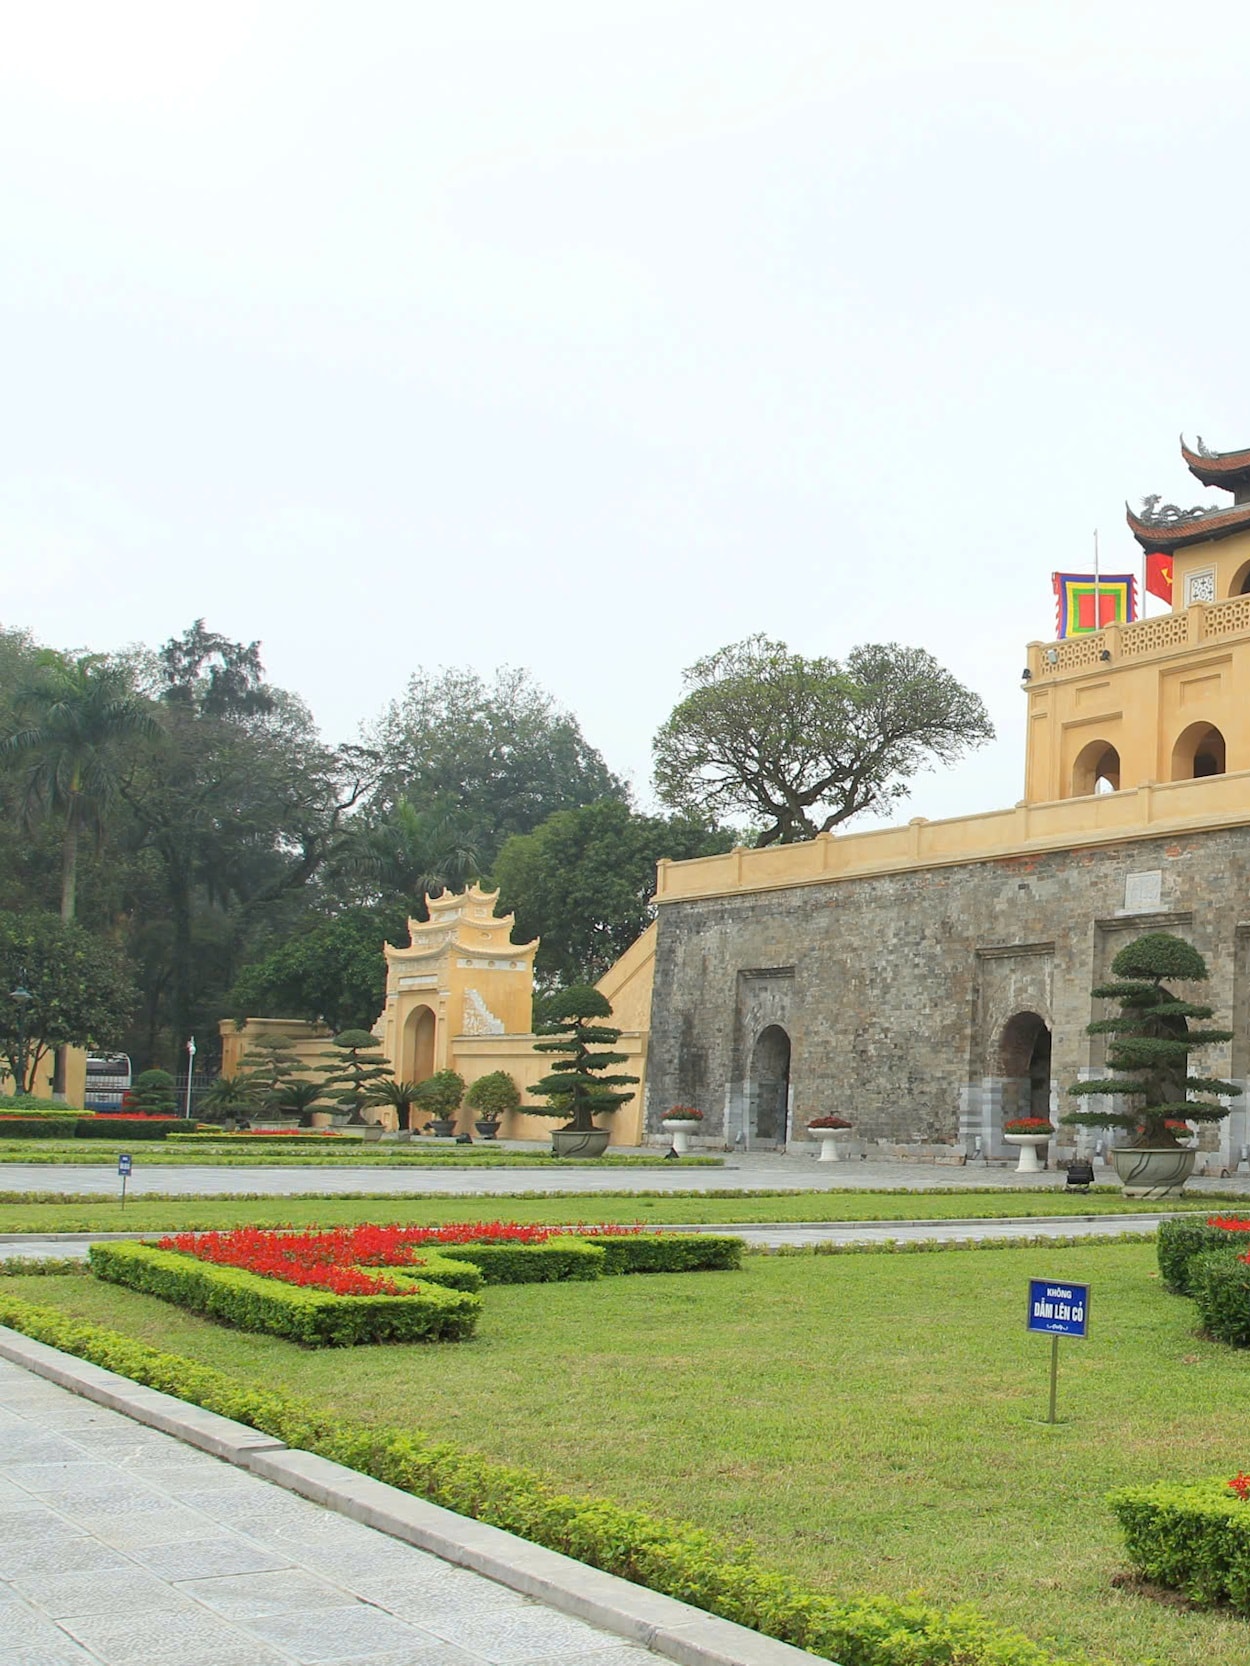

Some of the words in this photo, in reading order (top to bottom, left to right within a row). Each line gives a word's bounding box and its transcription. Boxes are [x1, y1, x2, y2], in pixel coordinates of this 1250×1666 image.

[1047, 1287, 1072, 1299] KHÔNG
[1054, 1302, 1071, 1321] LÊN
[1072, 1301, 1083, 1322] CỎ
